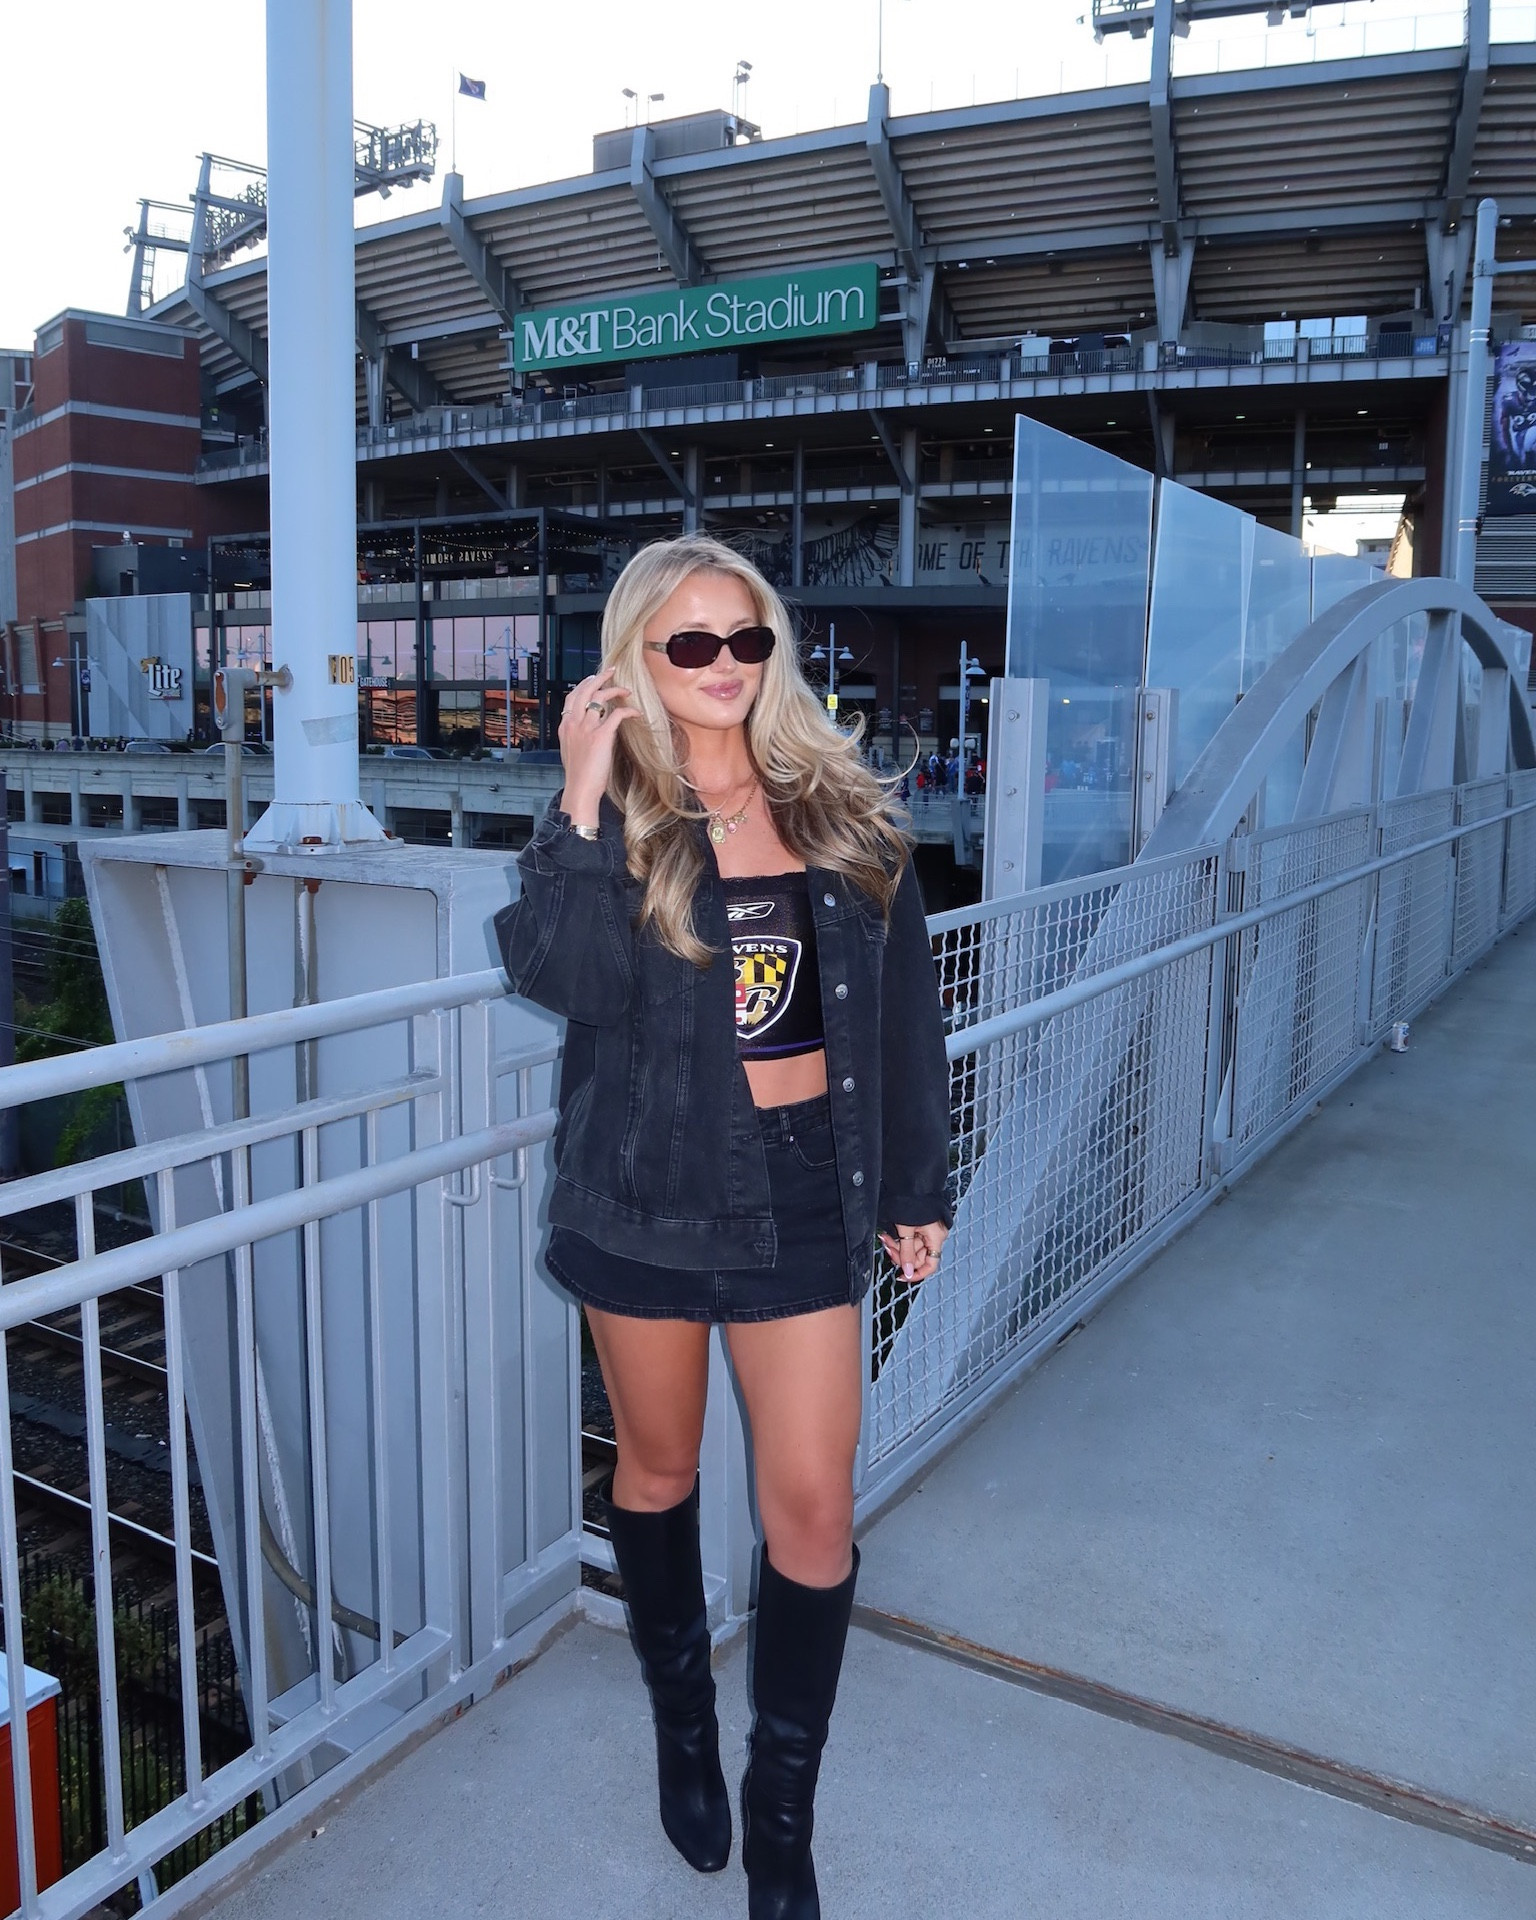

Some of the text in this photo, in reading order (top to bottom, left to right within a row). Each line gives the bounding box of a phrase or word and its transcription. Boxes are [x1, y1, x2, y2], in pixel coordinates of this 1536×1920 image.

[522, 283, 865, 362] M&T Bank Stadium
[959, 541, 986, 570] OF
[1048, 536, 1140, 567] RAVENS
[147, 664, 181, 697] Lite
[732, 943, 788, 955] VENS
